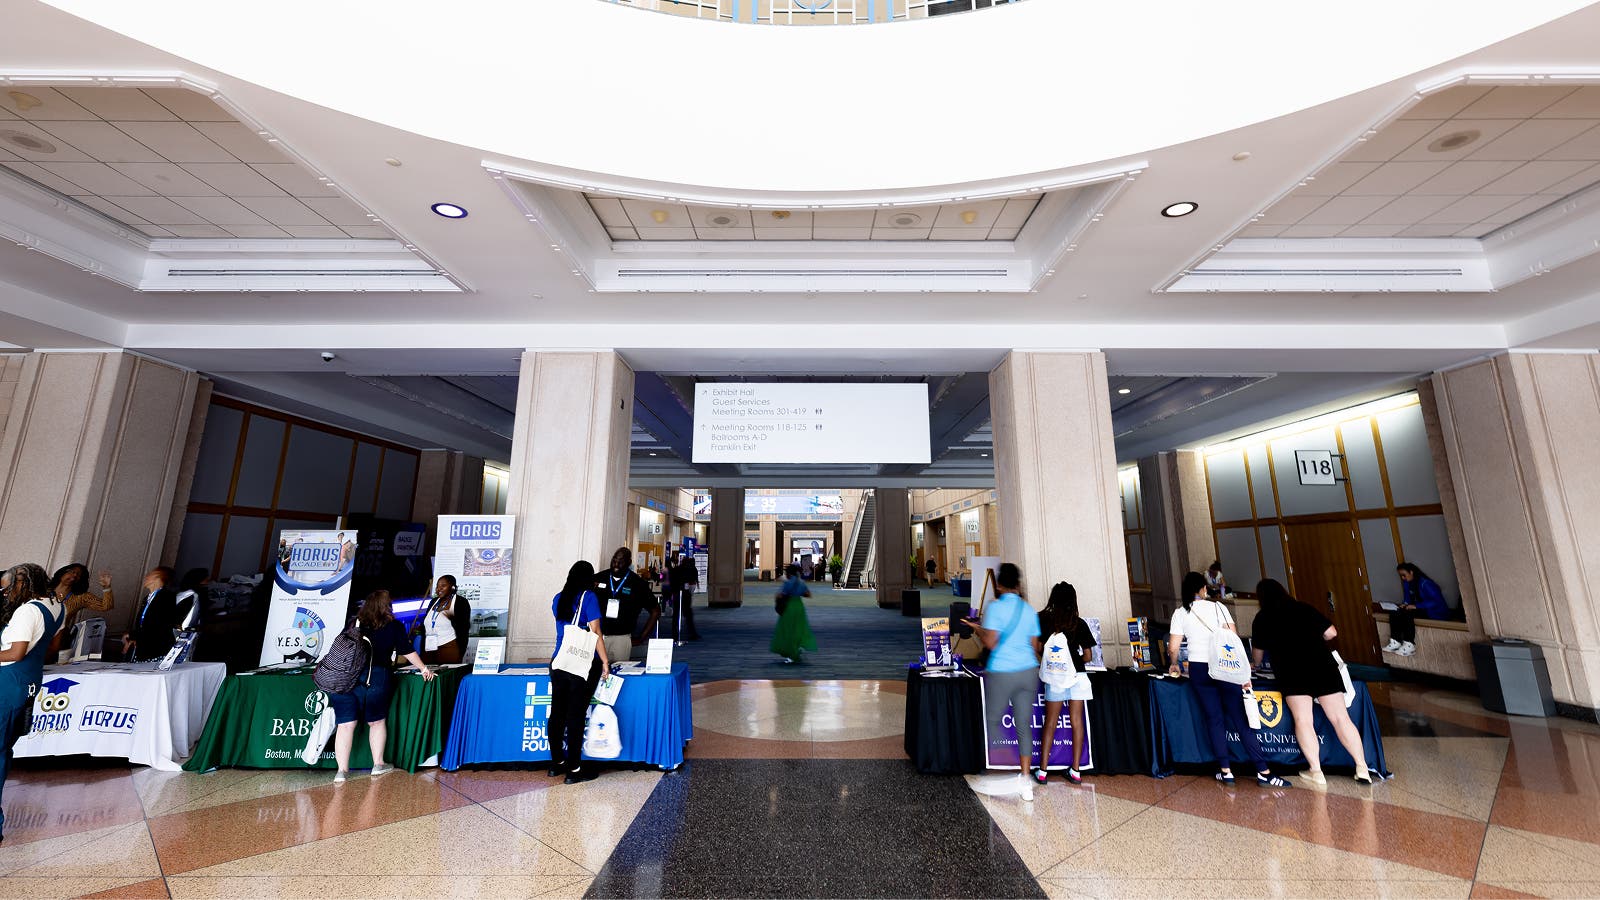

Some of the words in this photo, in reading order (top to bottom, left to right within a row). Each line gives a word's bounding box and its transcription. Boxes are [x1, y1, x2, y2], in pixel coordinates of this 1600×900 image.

[712, 388, 738, 397] Exhibit
[739, 388, 755, 397] Hall
[712, 398, 736, 406] Guest
[737, 398, 771, 406] Services
[711, 408, 746, 417] Meeting
[747, 408, 775, 416] Rooms
[776, 408, 807, 416] 301-419
[711, 423, 746, 432] Meeting
[747, 423, 775, 431] Rooms
[777, 423, 807, 431] 118-125
[751, 433, 768, 441] A-D
[710, 443, 742, 451] Franklin
[743, 443, 756, 451] Exit
[1300, 459, 1332, 475] 118
[450, 524, 501, 537] HORUS
[292, 547, 340, 562] HORUS
[277, 636, 303, 647] Y.E.S.
[81, 710, 137, 729] HORUS
[264, 748, 292, 759] Boston,
